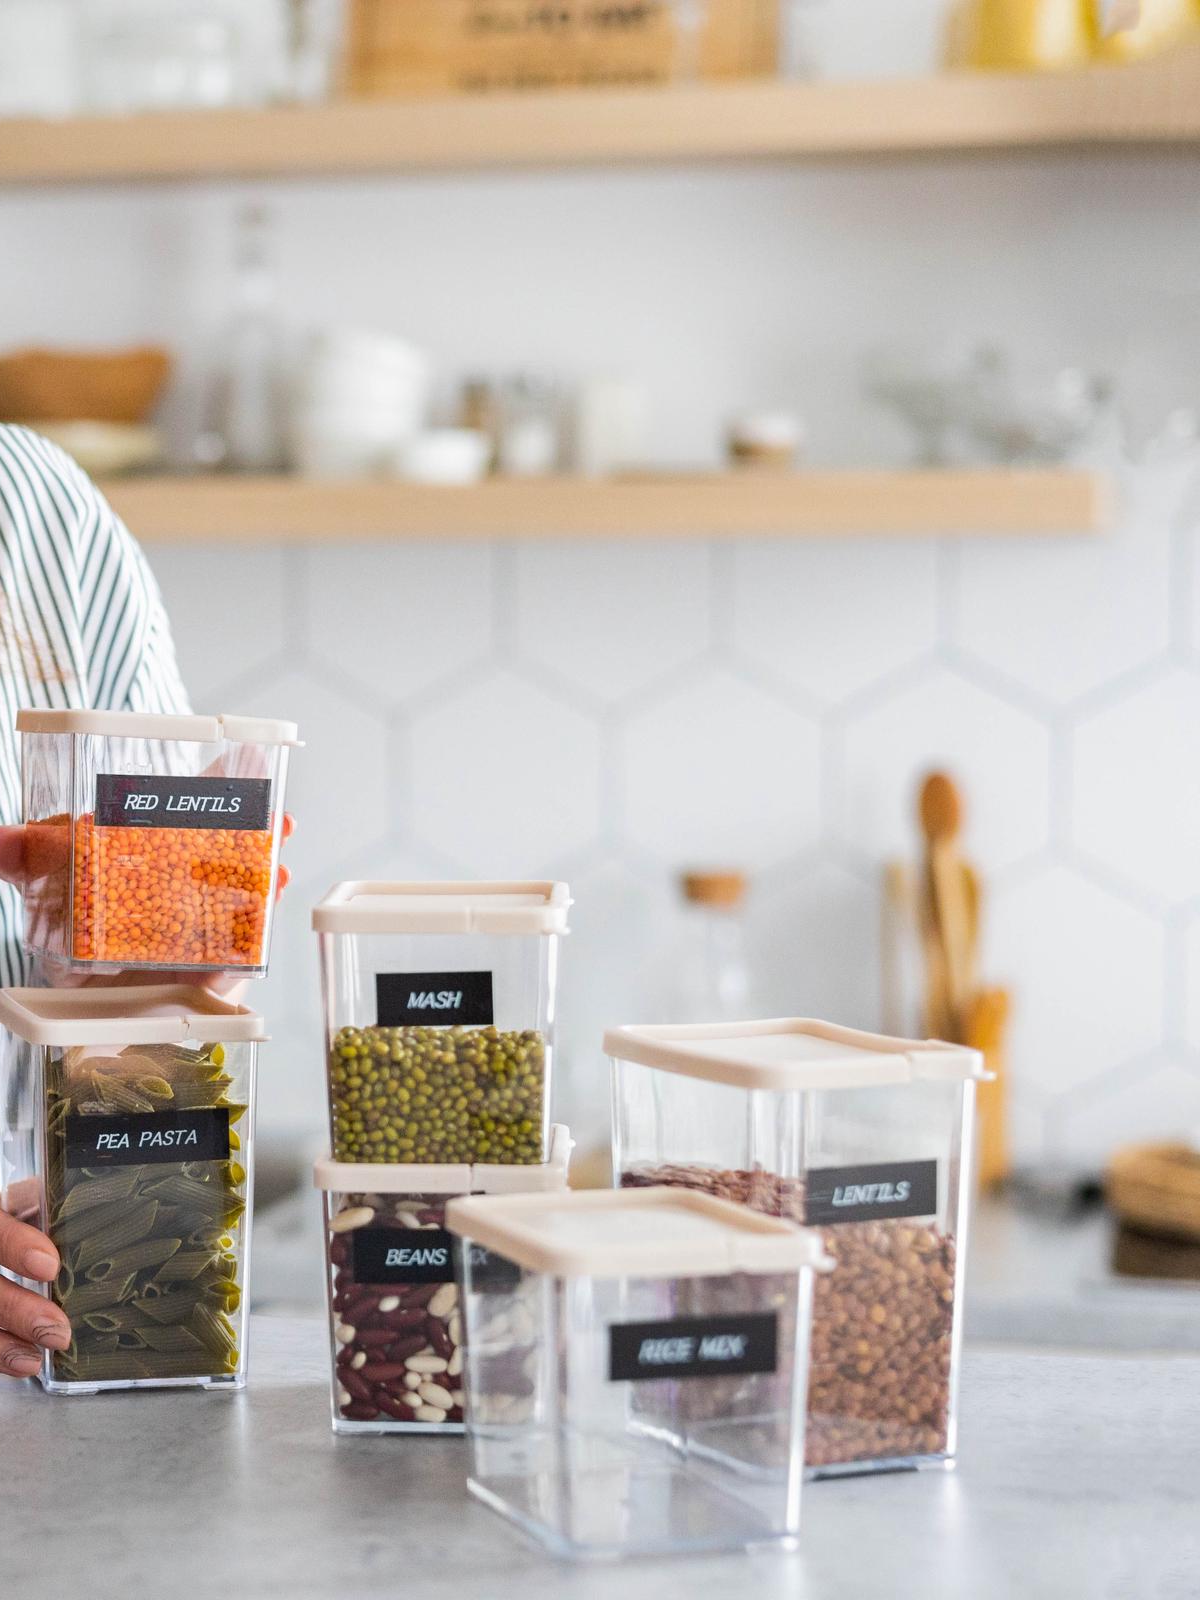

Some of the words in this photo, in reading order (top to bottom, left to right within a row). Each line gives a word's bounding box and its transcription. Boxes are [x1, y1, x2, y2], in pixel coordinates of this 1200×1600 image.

[124, 794, 158, 810] RED
[165, 796, 241, 812] LENTILS
[406, 990, 463, 1009] MASH
[96, 1133, 131, 1150] PEA
[138, 1129, 198, 1147] PASTA
[831, 1180, 912, 1207] LENTILS
[385, 1248, 448, 1266] BEANS
[638, 1336, 694, 1365] RICE
[699, 1334, 748, 1361] MIX
